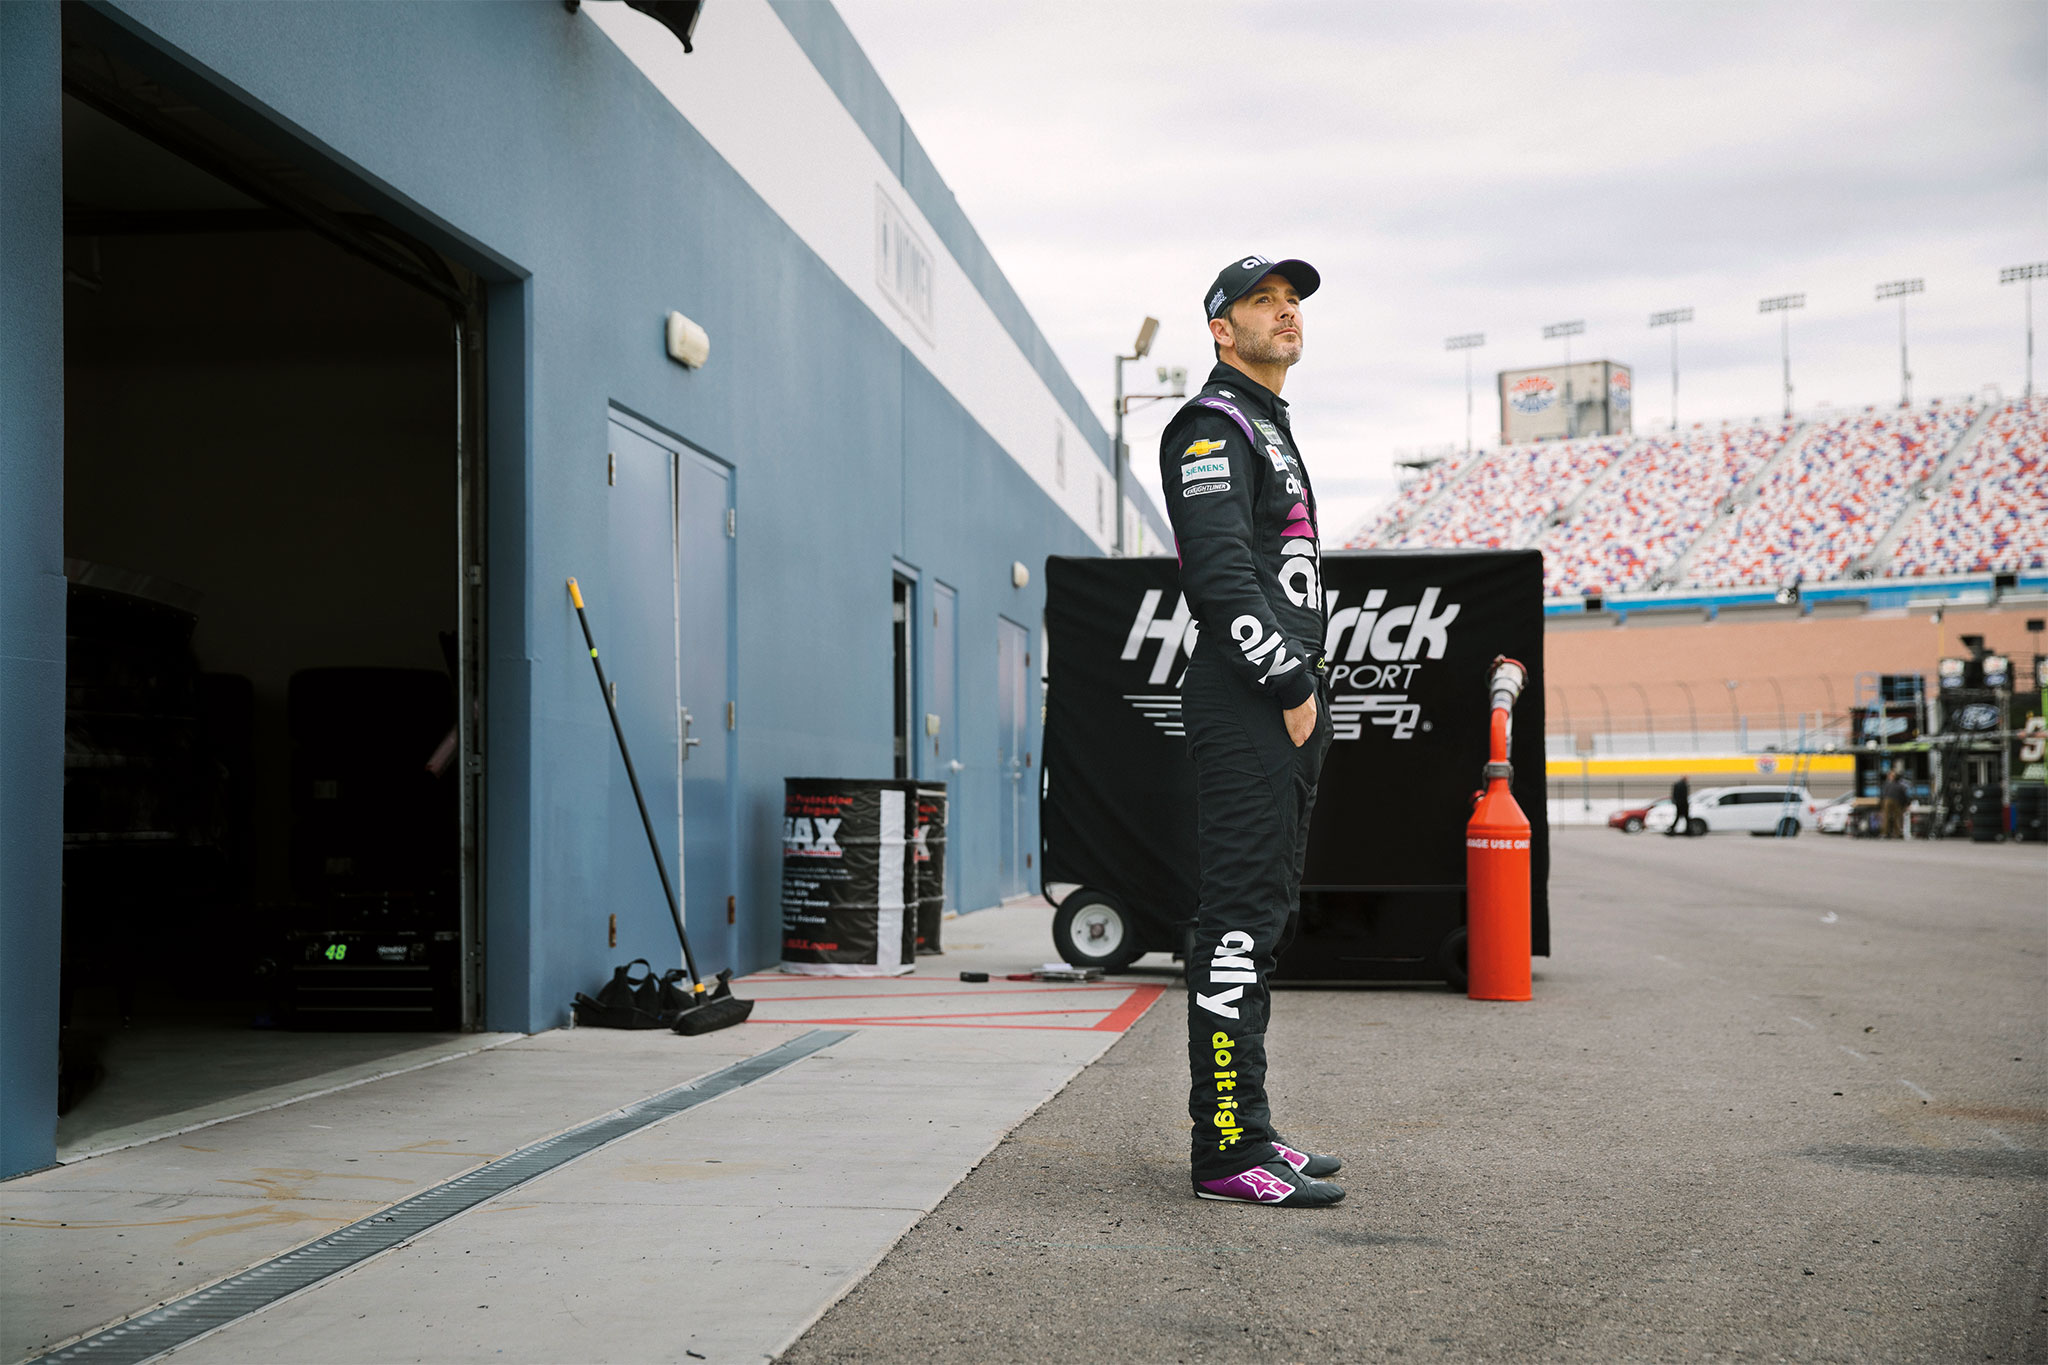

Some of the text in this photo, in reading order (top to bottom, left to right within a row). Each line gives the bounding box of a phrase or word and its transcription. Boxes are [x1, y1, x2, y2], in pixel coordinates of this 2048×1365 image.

[1185, 463, 1225, 477] SIEMENS
[1185, 483, 1227, 496] FREIGHTLINER
[1230, 614, 1302, 685] ally
[1490, 839, 1513, 849] USE
[325, 944, 347, 960] 48
[1196, 930, 1258, 1020] ally
[1212, 1031, 1235, 1067] do
[1214, 1070, 1237, 1092] it
